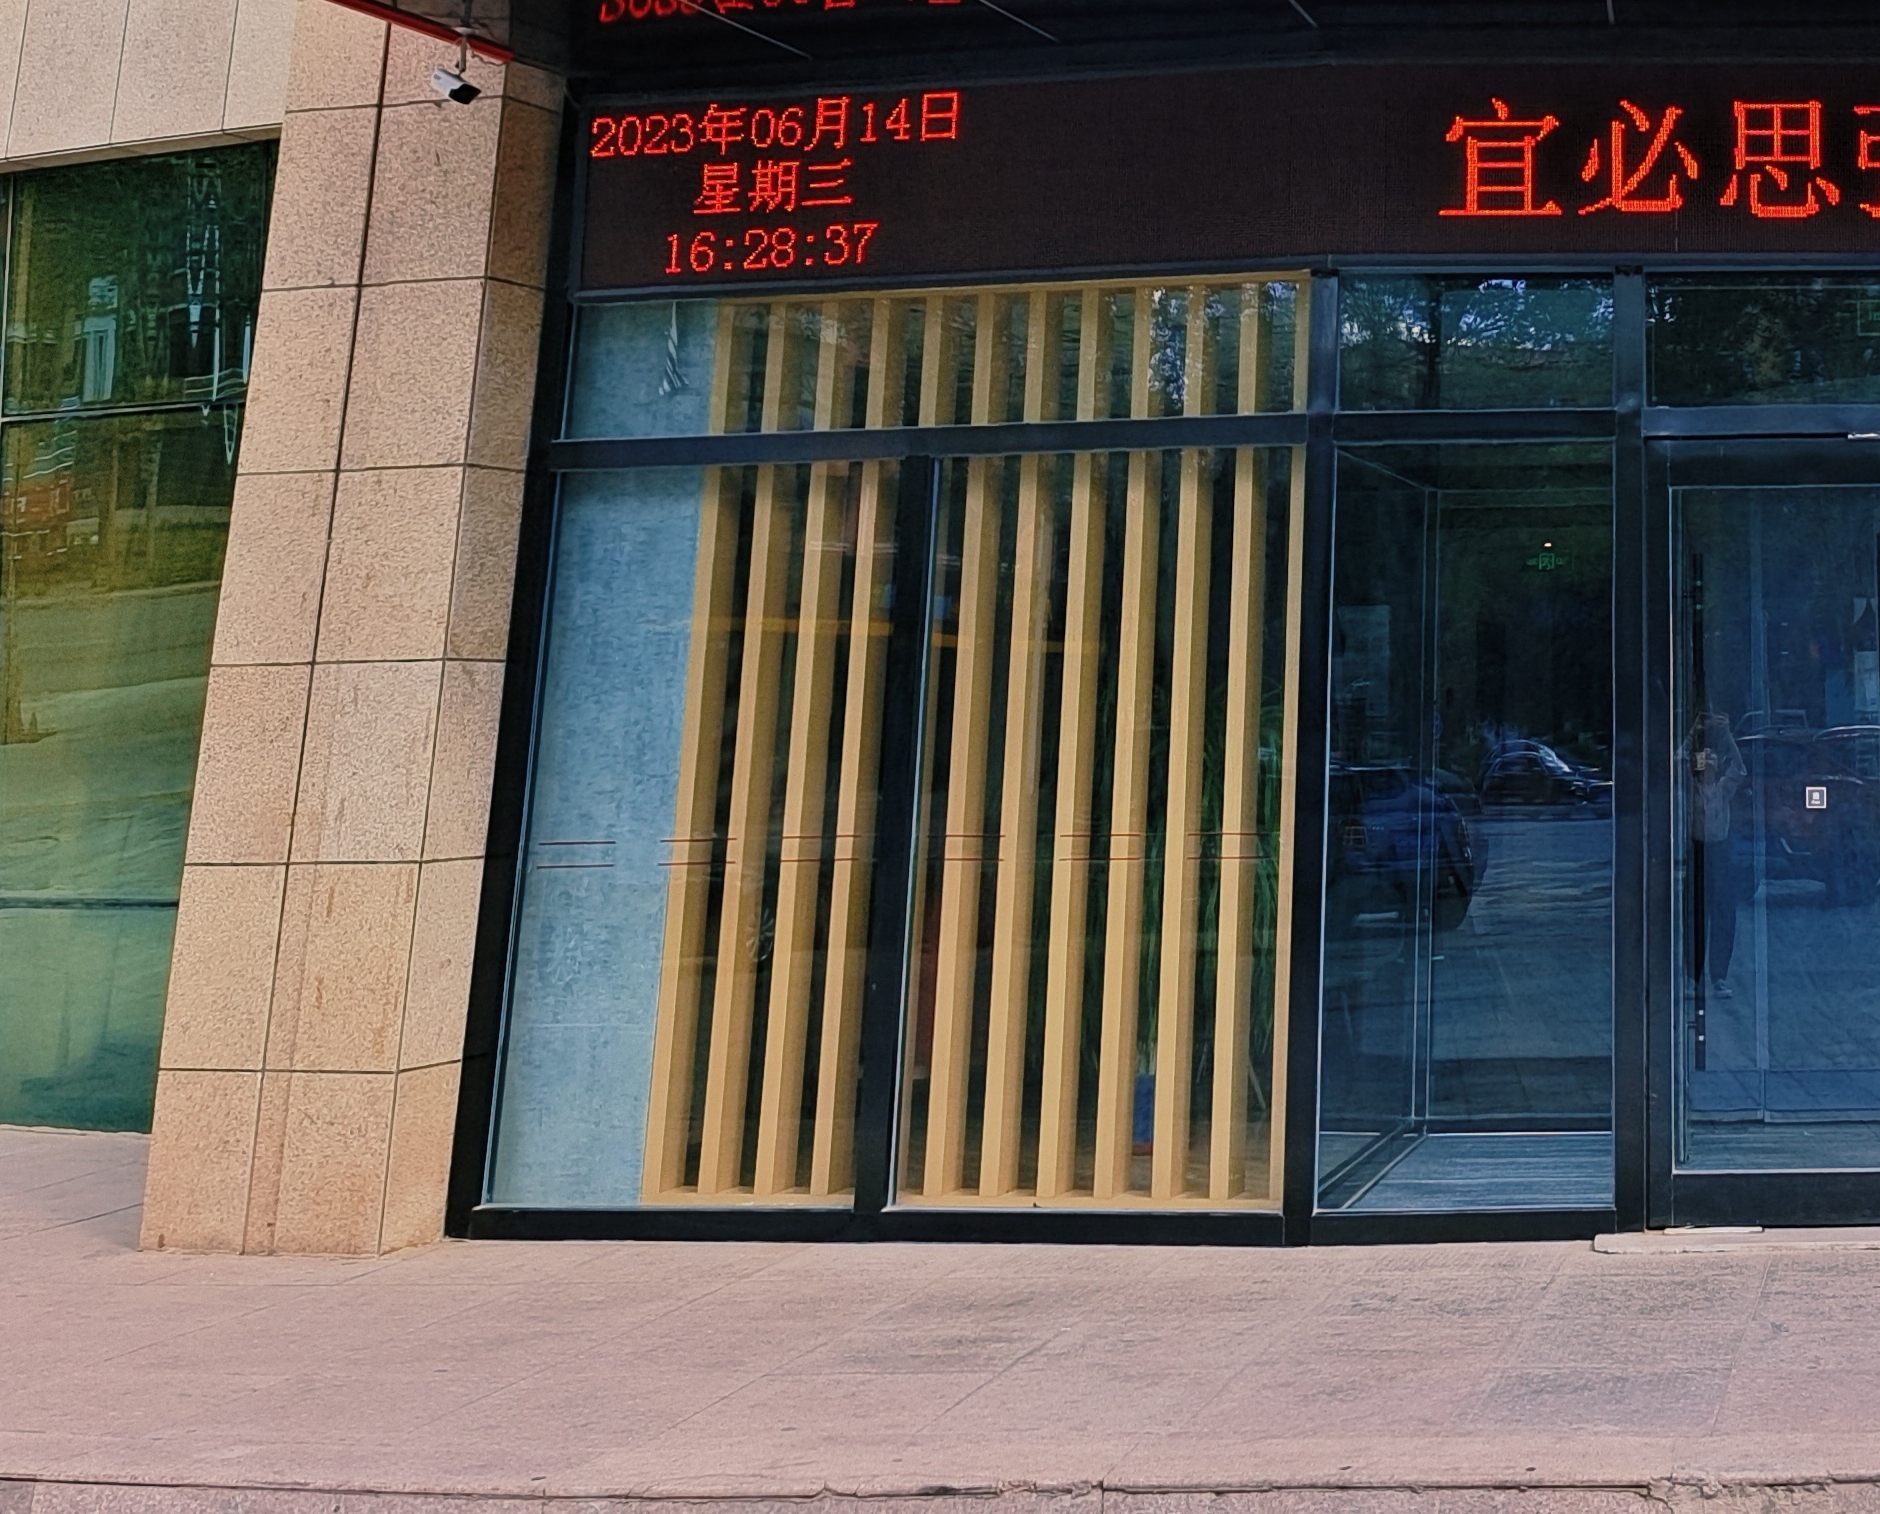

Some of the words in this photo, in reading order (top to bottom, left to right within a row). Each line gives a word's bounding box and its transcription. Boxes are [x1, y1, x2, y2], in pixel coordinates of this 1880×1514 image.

[590, 91, 962, 157] 2023年06月14日
[693, 158, 854, 215] 星期三
[664, 222, 880, 275] 16:28:37
